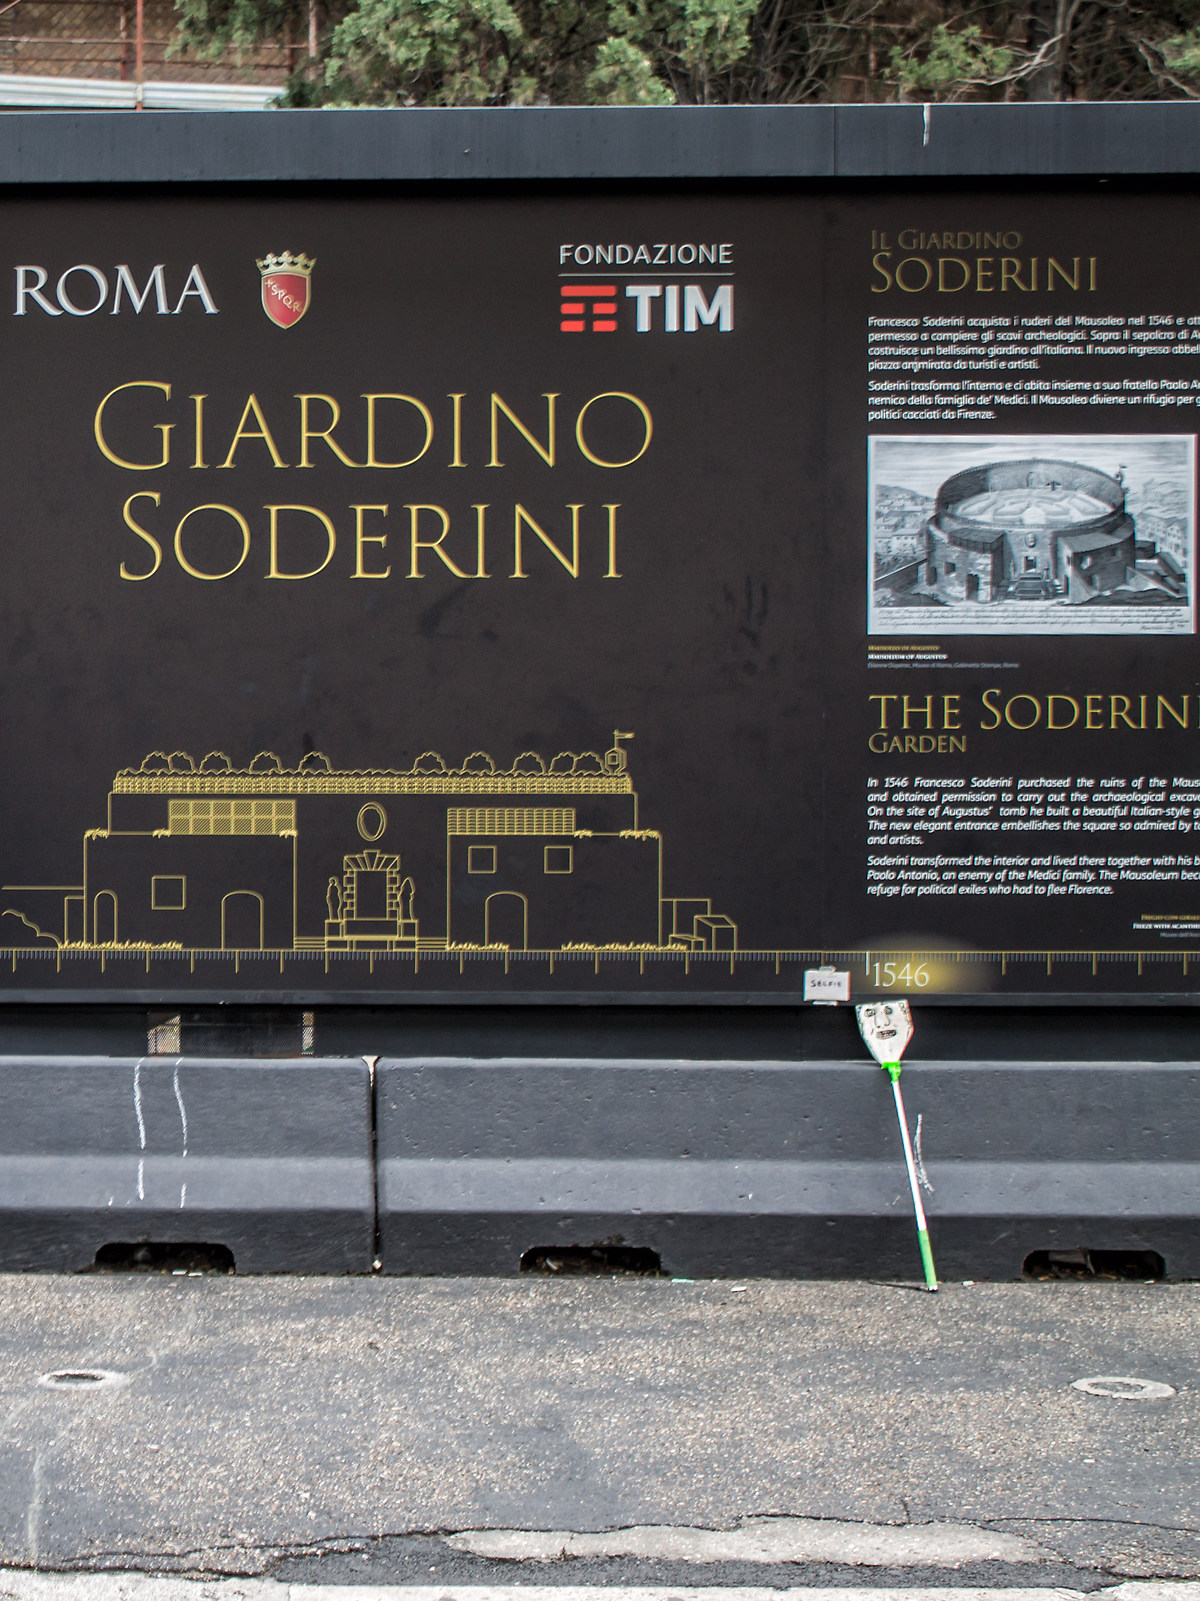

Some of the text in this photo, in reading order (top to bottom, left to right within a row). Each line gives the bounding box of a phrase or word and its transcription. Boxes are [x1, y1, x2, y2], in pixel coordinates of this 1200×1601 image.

[871, 228, 1022, 250] IL GIARDINO
[559, 244, 734, 265] FONDAZIONE
[871, 252, 1097, 292] SODERINI
[13, 264, 220, 316] ROMA
[626, 285, 734, 333] TIM
[868, 315, 1185, 329] Francesco Soderini acquista i ruderi del Mausoleo nel 1546 e
[868, 344, 1171, 357] costruisce un bellissimo giardino all'italiana. Il nuovo ingresso
[868, 408, 996, 422] politici cacciati da Firenze.
[94, 381, 653, 470] GIARDINO
[119, 491, 623, 581] SODERINI
[868, 695, 962, 729] THE
[868, 732, 967, 753] GARDEN
[867, 777, 1167, 790] In 1546 Francesco Soderini purchased the ruins of the
[867, 791, 1166, 804] and obtained permission to carry out the archaeological
[867, 806, 1191, 819] On the site of Augustus' tomb he built a beautiful Italian-style
[869, 820, 1192, 833] The new elegant entrance embellishes the square so admired by
[867, 834, 924, 844] and artists.
[867, 869, 1180, 882] Paolo Antonio, an enemy of the Medici family. The Mausoleum
[867, 884, 1114, 897] refuge for political exiles who had to flee Florence.
[873, 963, 929, 987] 1546
